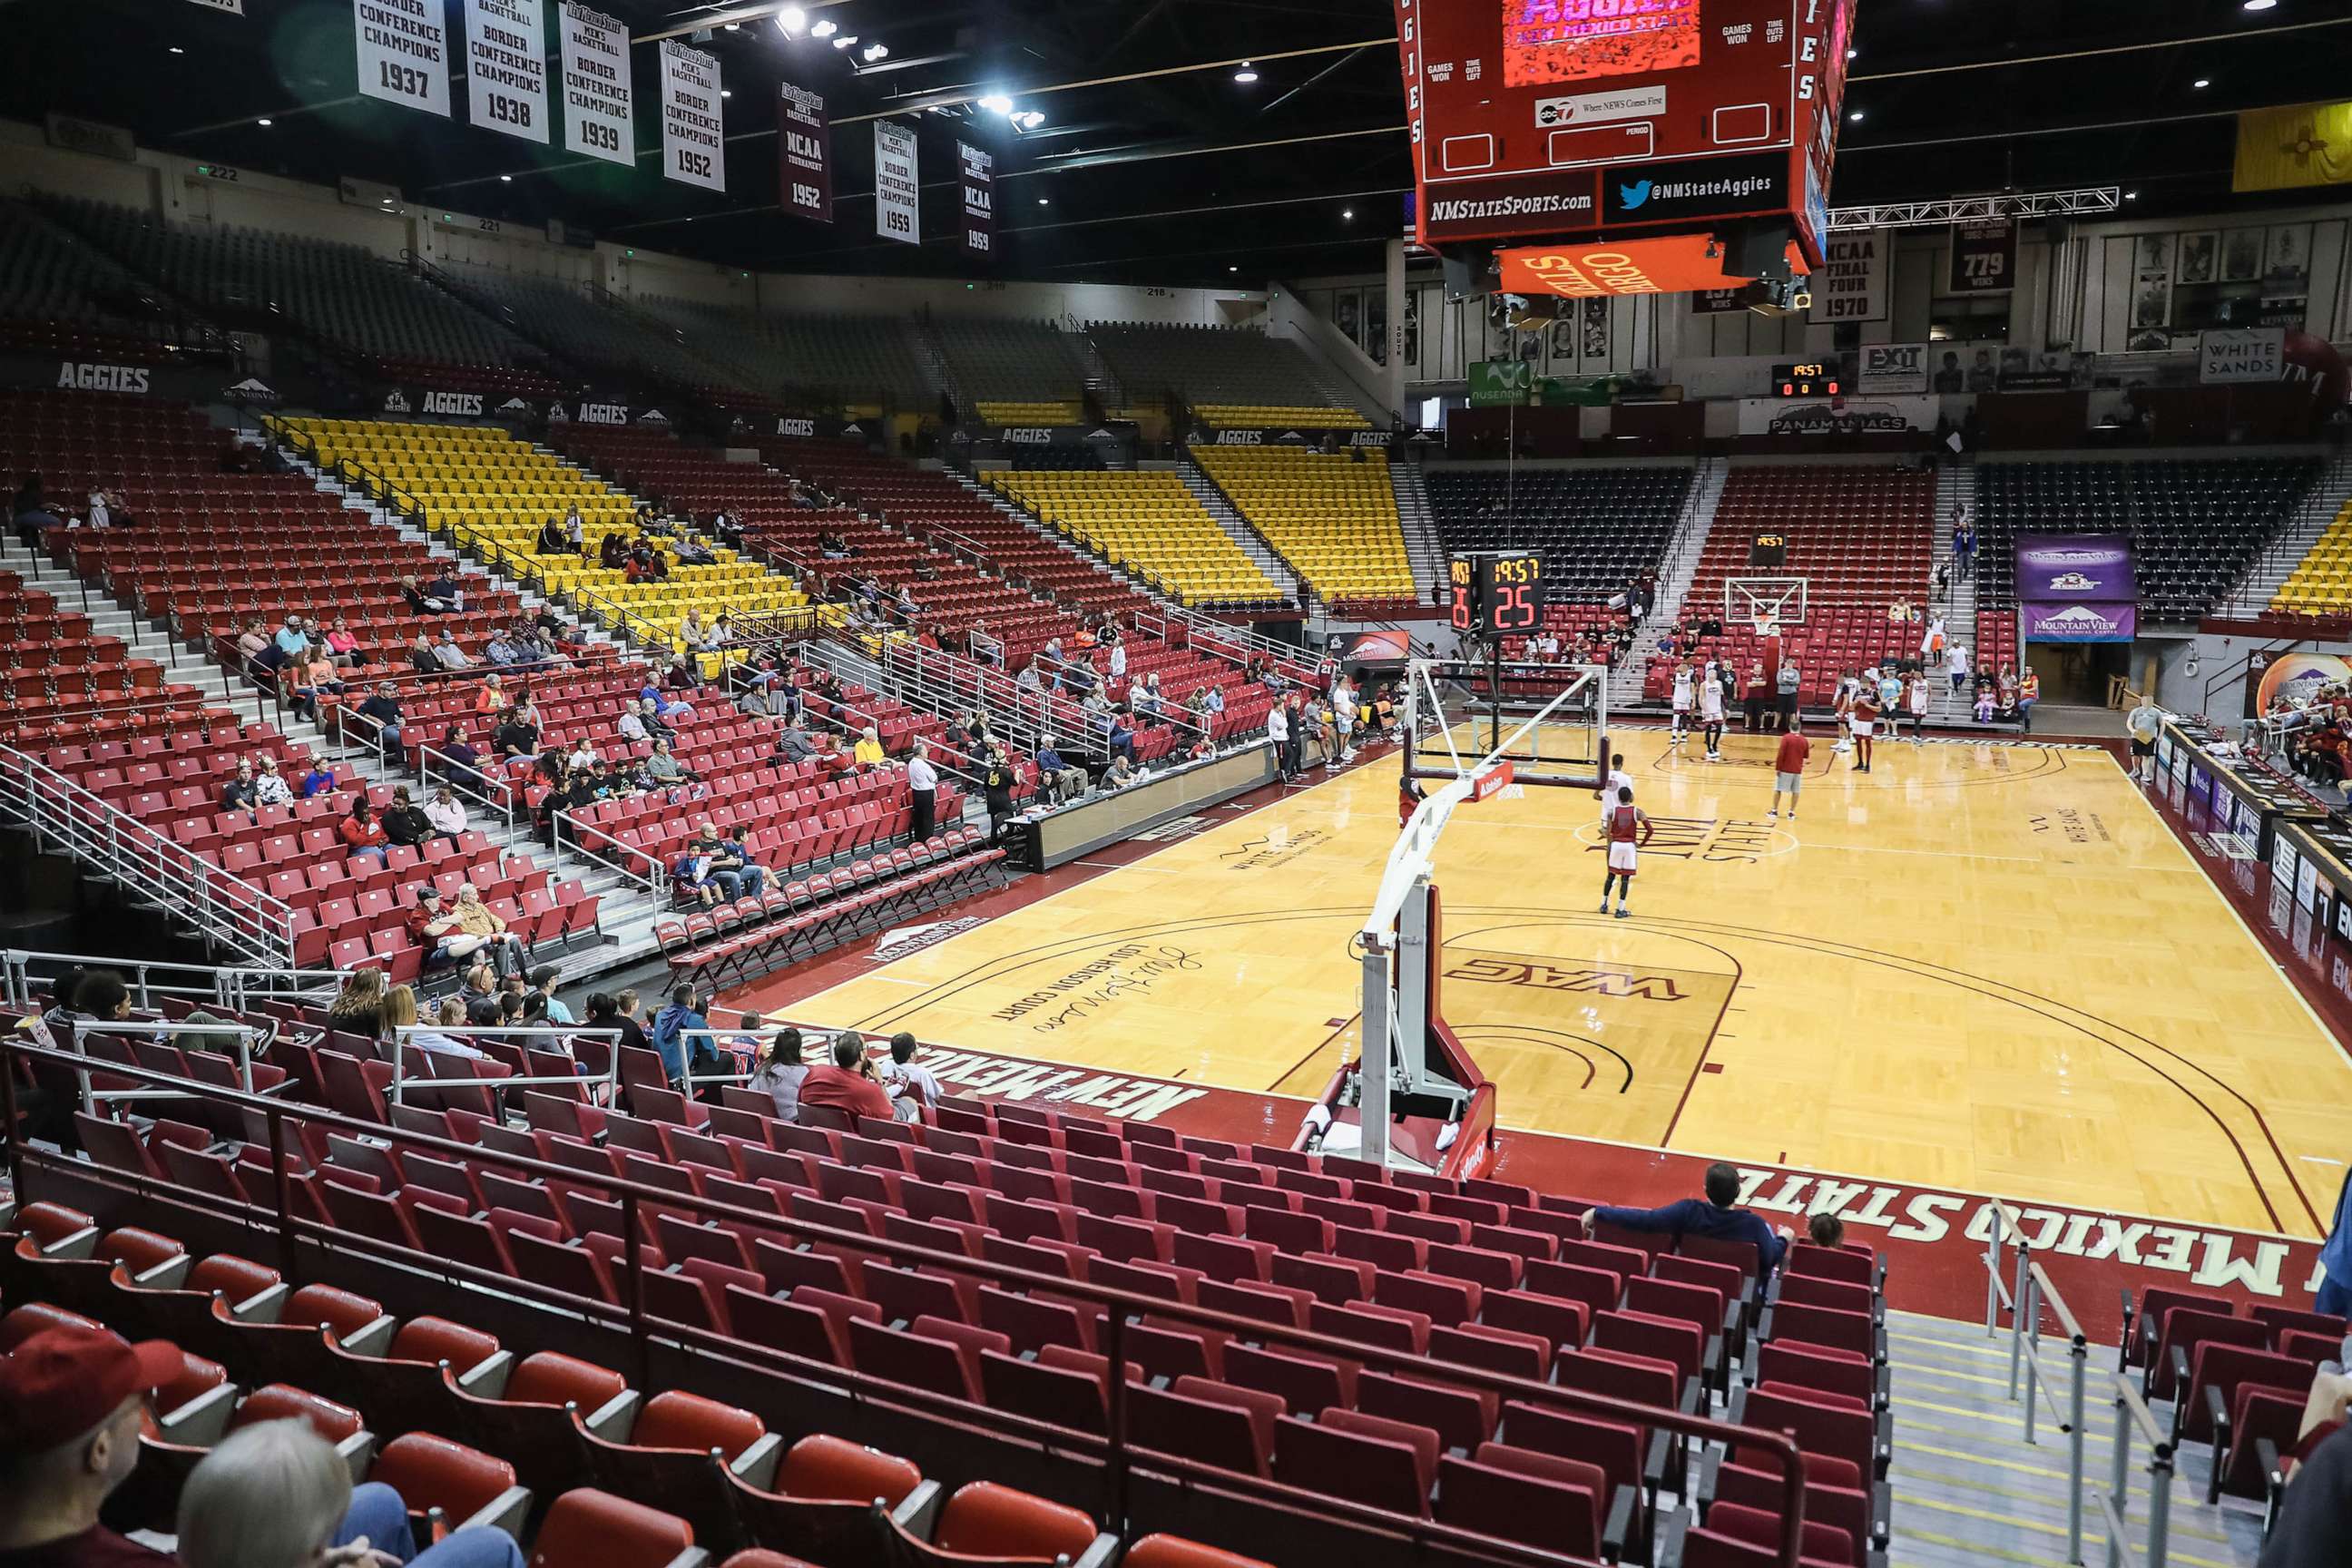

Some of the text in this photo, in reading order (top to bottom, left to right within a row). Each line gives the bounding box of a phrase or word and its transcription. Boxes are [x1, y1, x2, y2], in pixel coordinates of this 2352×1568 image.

[373, 0, 425, 17] RDER
[479, 0, 541, 26] BASKETBALL
[359, 4, 441, 43] CONFERENCE
[1563, 18, 1632, 38] MEXICO
[1722, 24, 1752, 36] GAMES
[1766, 26, 1784, 36] OUTS
[1767, 19, 1783, 28] TIME
[483, 24, 527, 53] BORDER
[583, 26, 606, 42] MEN'S
[1727, 34, 1748, 45] WON
[1767, 34, 1783, 44] LEFT
[364, 26, 440, 63] CHAMPIONS
[573, 33, 619, 56] BASKETBALL
[471, 41, 542, 75] CONFERENCE
[681, 61, 701, 75] MEN'S
[1465, 59, 1481, 67] TIME
[475, 61, 541, 93] CHAMPIONS
[577, 56, 616, 81] BORDER
[1427, 63, 1454, 74] GAMES
[1431, 73, 1450, 83] WON
[1465, 65, 1481, 74] OUTS
[1466, 73, 1481, 81] LEFT
[380, 60, 428, 98] 1937
[566, 73, 629, 103] CONFERENCE
[671, 68, 712, 90] BASKETBALL
[487, 93, 531, 127] 1938
[569, 92, 628, 120] CHAMPIONS
[675, 90, 710, 113] BORDER
[1583, 96, 1662, 113] Where NEWS Comes First
[666, 104, 720, 132] CONFERENCE
[787, 109, 821, 128] BASKETBALL
[1541, 110, 1558, 118] abc
[581, 120, 619, 152] 1939
[668, 122, 720, 149] CHAMPIONS
[1626, 127, 1649, 135] PERIOD
[787, 131, 822, 161] NCAA
[678, 149, 711, 178] 1952
[789, 154, 823, 172] TOURNAMENT
[885, 162, 908, 177] BORDER
[208, 165, 239, 182] 222
[878, 174, 916, 194] CONFERENCE
[1651, 176, 1771, 201] @NMStateAggies
[792, 182, 820, 209] 1952
[880, 189, 916, 208] CHAMPIONS
[965, 186, 991, 210] NCAA
[479, 218, 500, 233] 221
[887, 211, 910, 232] 1959
[968, 230, 989, 251] 1959
[1581, 252, 1664, 296] FARGO
[1827, 261, 1869, 277] FINAL
[1963, 252, 2004, 277] 779
[1828, 278, 1867, 292] FOUR
[1971, 277, 1994, 287] WINS
[1147, 288, 1166, 298] 218
[1826, 298, 1867, 317] 1970
[1867, 347, 1923, 369] EXIT
[2209, 341, 2277, 358] WHITE
[1793, 364, 1823, 377] 19:57
[2208, 359, 2275, 375] SANDS
[58, 363, 149, 393] AGGIES
[1783, 382, 1838, 396] 0 0 0
[422, 391, 484, 416] AGGIES
[577, 403, 628, 426] AGGIES
[776, 417, 815, 436] AGGIES
[1002, 427, 1053, 444] AGGIES
[1216, 430, 1263, 446] AGGIES
[1349, 431, 1394, 446] AGGIES
[1494, 558, 1540, 583] 19:57
[1494, 584, 1535, 629] 25
[2034, 620, 2120, 631] MOUNTAIN VIEW
[1321, 664, 1332, 674] 21
[1702, 819, 1777, 863] STATE
[991, 944, 1150, 1022] LOU HENSON COURT
[1443, 959, 1690, 1001] WAC
[1067, 1071, 1210, 1122] NEW
[1964, 1201, 2291, 1298] MEXICO
